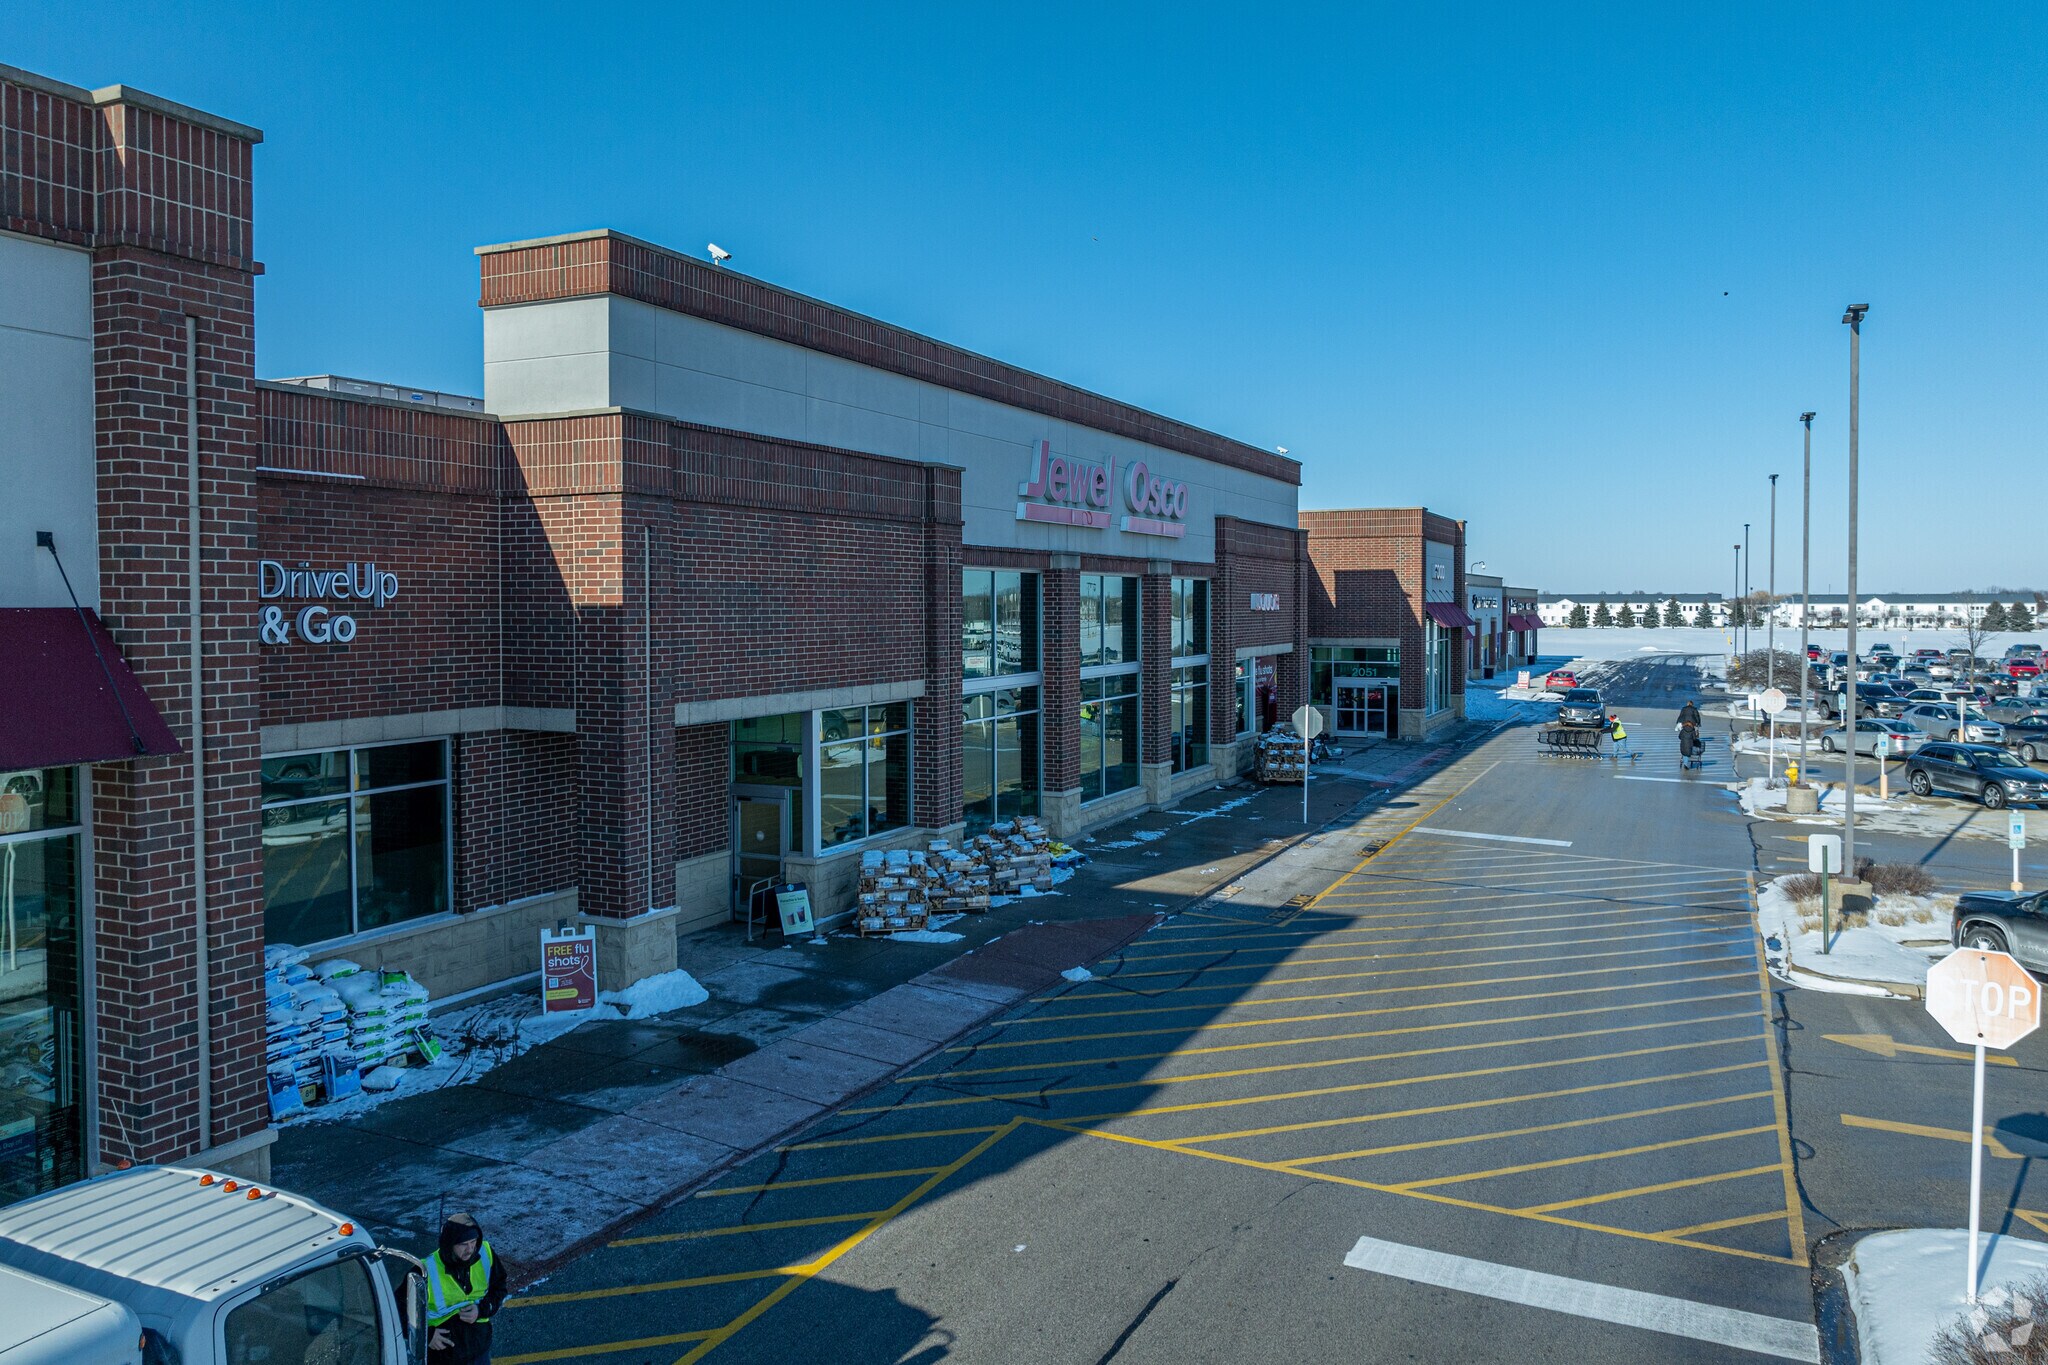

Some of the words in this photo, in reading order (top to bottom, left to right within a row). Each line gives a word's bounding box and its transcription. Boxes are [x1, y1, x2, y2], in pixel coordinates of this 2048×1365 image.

[1019, 440, 1116, 507] Jewel
[1124, 461, 1189, 519] Osco
[259, 560, 399, 608] DriveUp
[259, 605, 290, 645] &
[296, 605, 357, 644] Go
[1352, 668, 1377, 677] 2051
[547, 945, 572, 956] FREE
[575, 943, 589, 954] flu
[1938, 977, 2031, 1020] TOP
